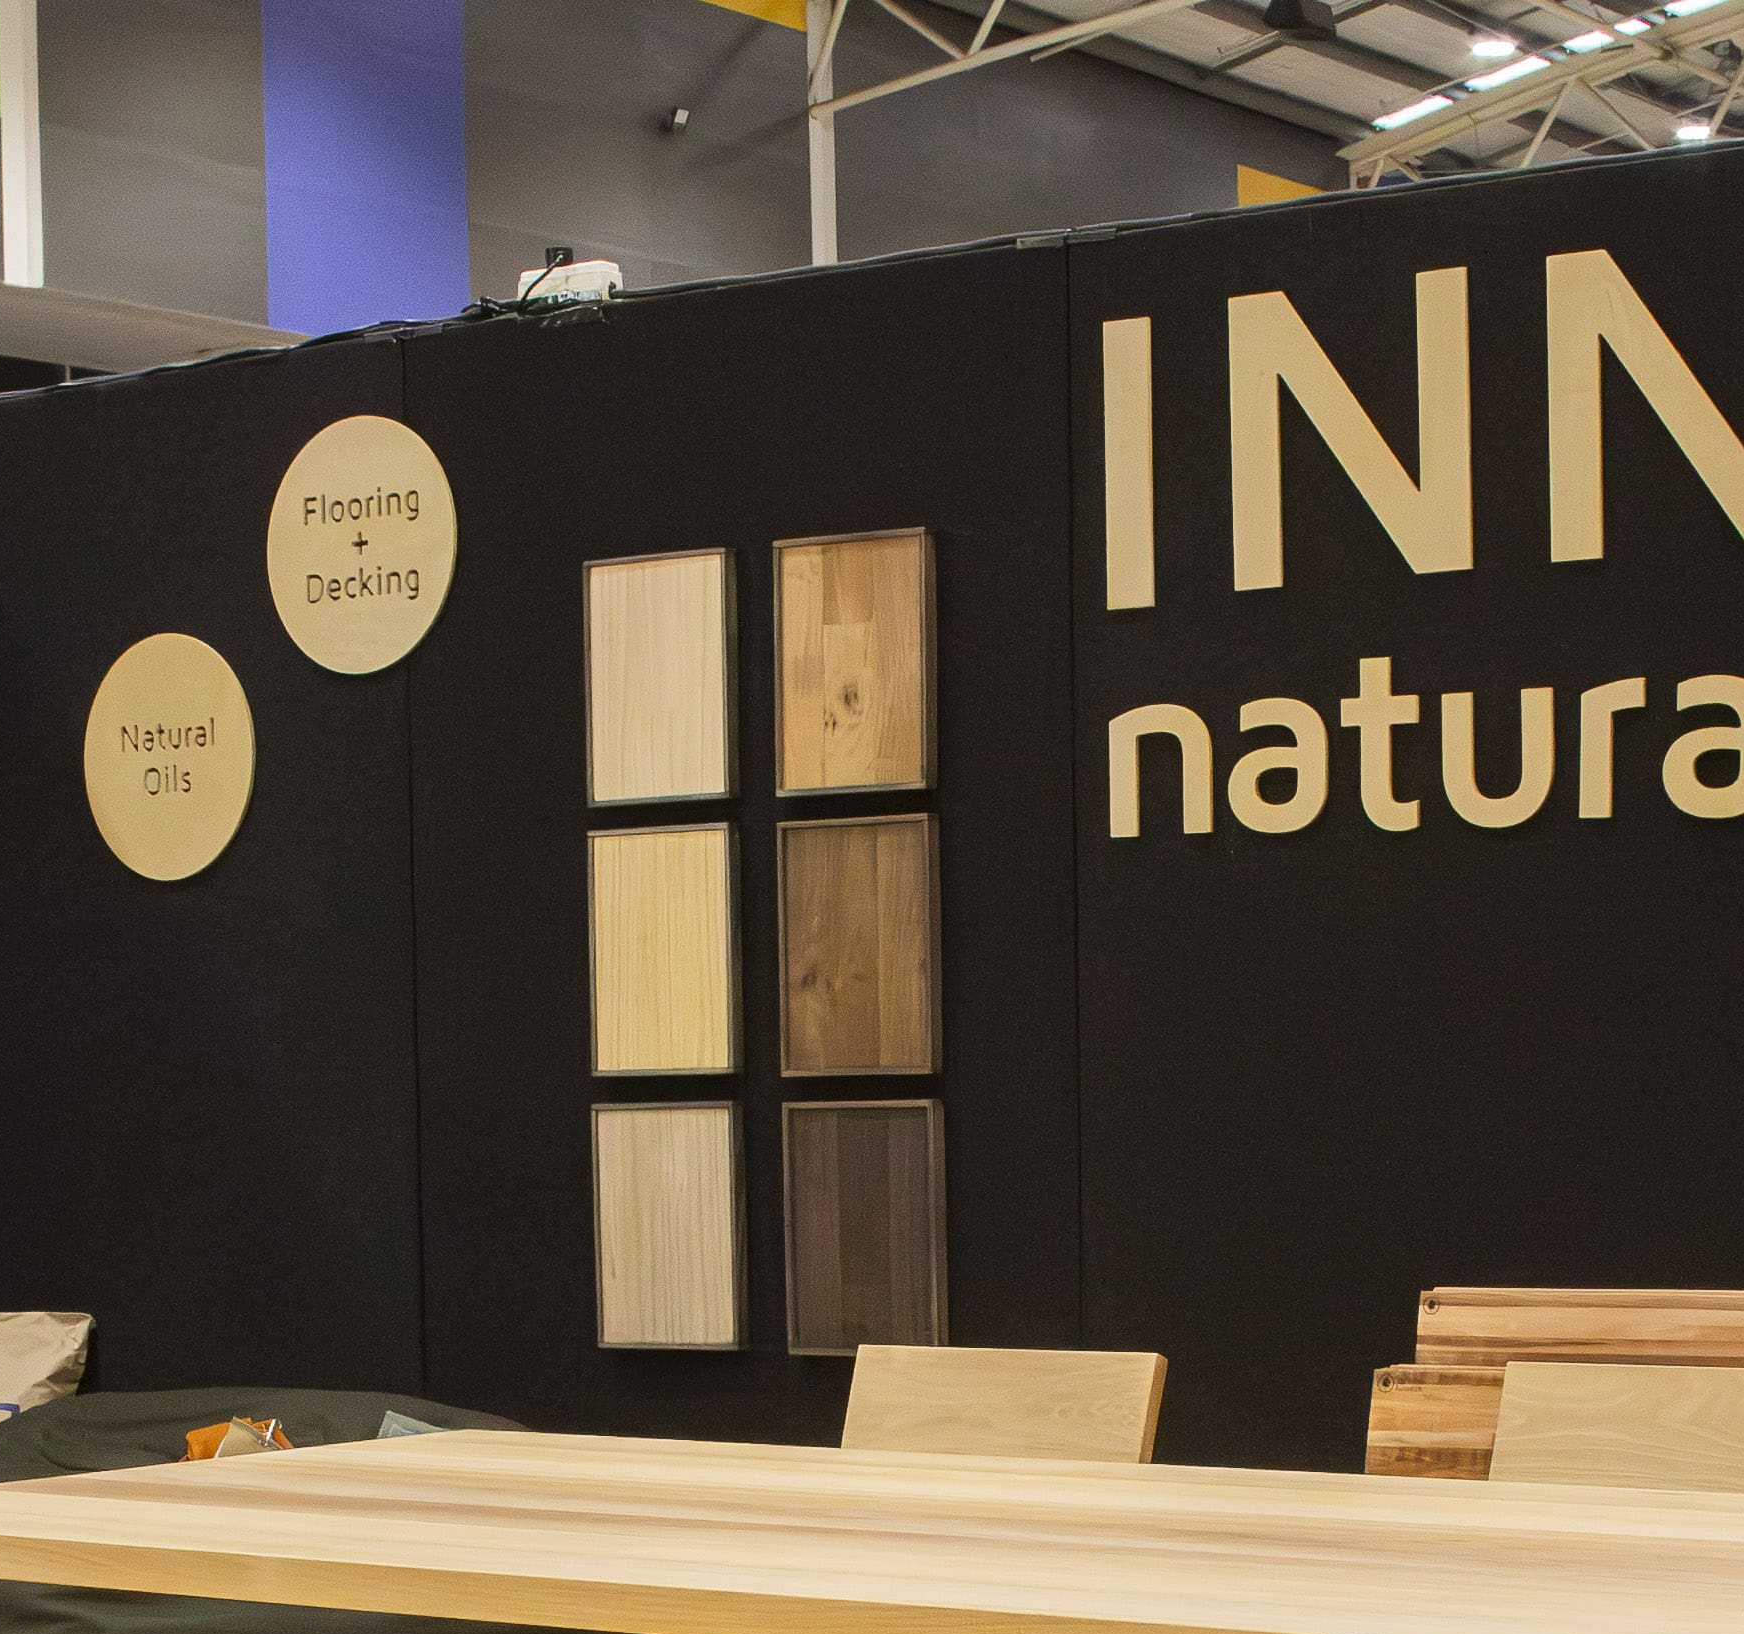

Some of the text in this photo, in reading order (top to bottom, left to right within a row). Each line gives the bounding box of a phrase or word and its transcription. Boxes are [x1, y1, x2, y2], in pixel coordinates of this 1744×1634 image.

[303, 486, 420, 526] Flooring
[306, 566, 420, 604] Decking
[120, 716, 215, 752] Natural
[143, 764, 192, 796] Oils
